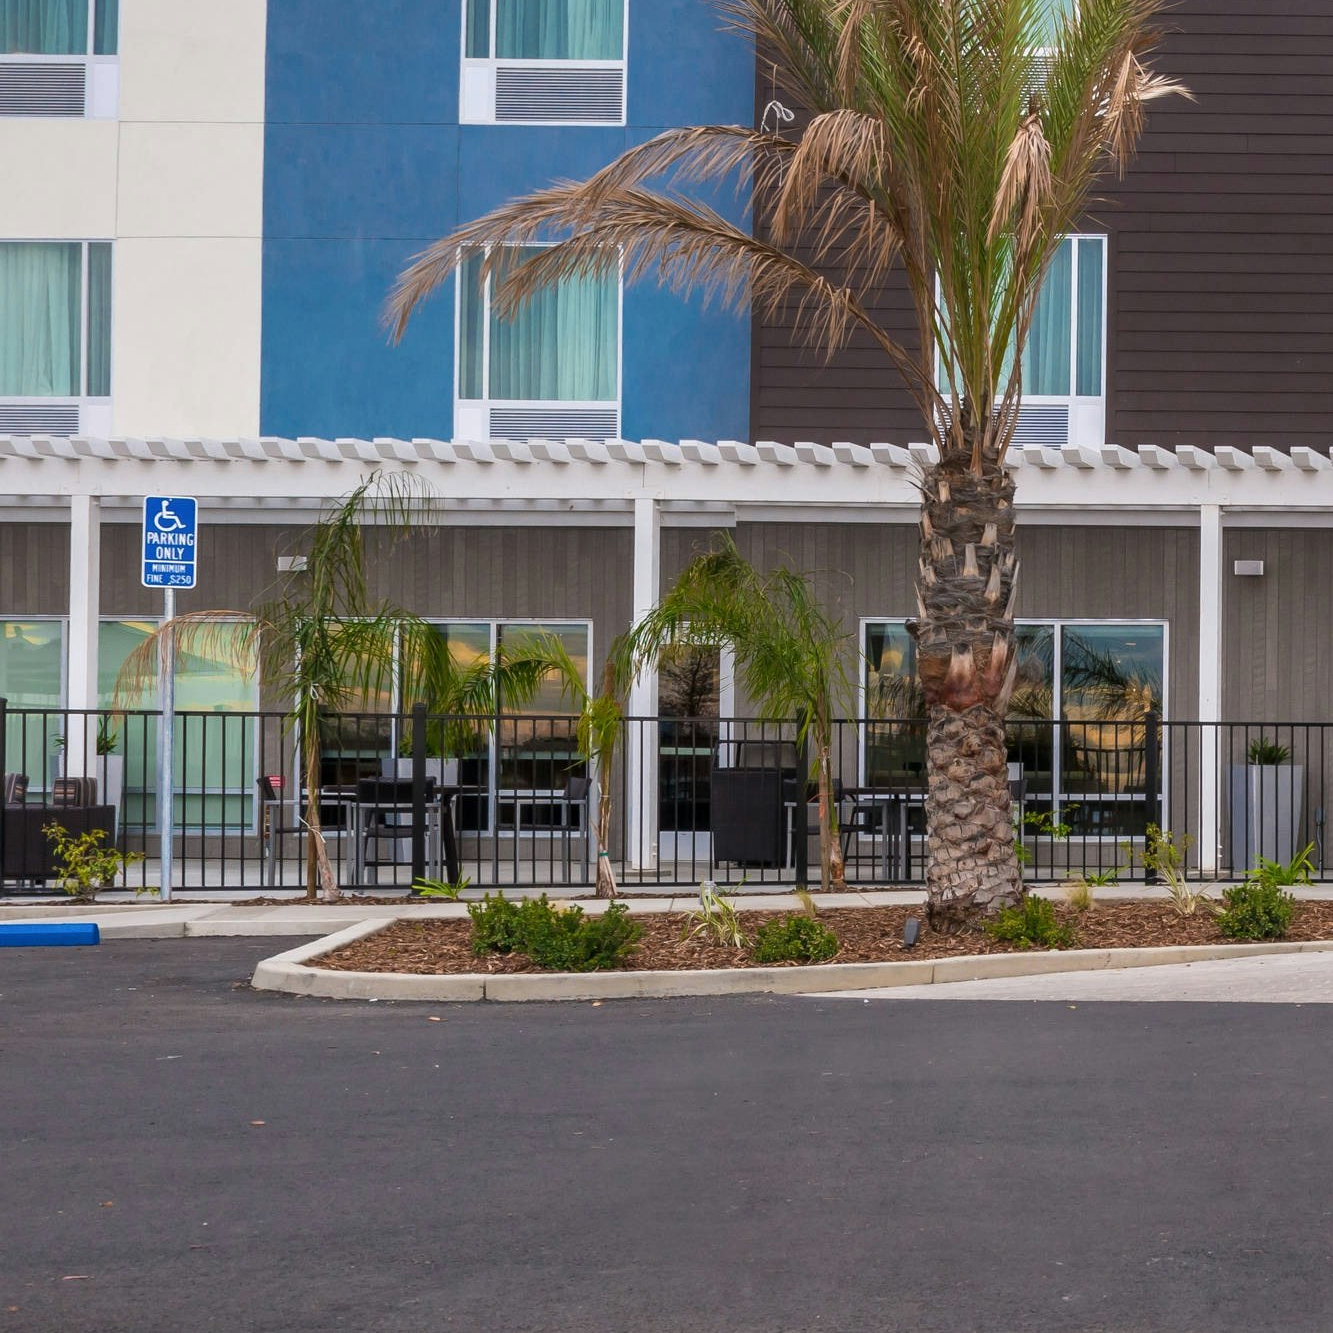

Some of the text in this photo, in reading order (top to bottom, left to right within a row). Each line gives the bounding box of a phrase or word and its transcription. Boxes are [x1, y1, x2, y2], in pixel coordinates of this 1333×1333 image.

[147, 532, 194, 546] PARKING
[155, 546, 184, 560] ONLY
[152, 564, 186, 573] MINIMUM
[147, 573, 192, 585] FINE $250
